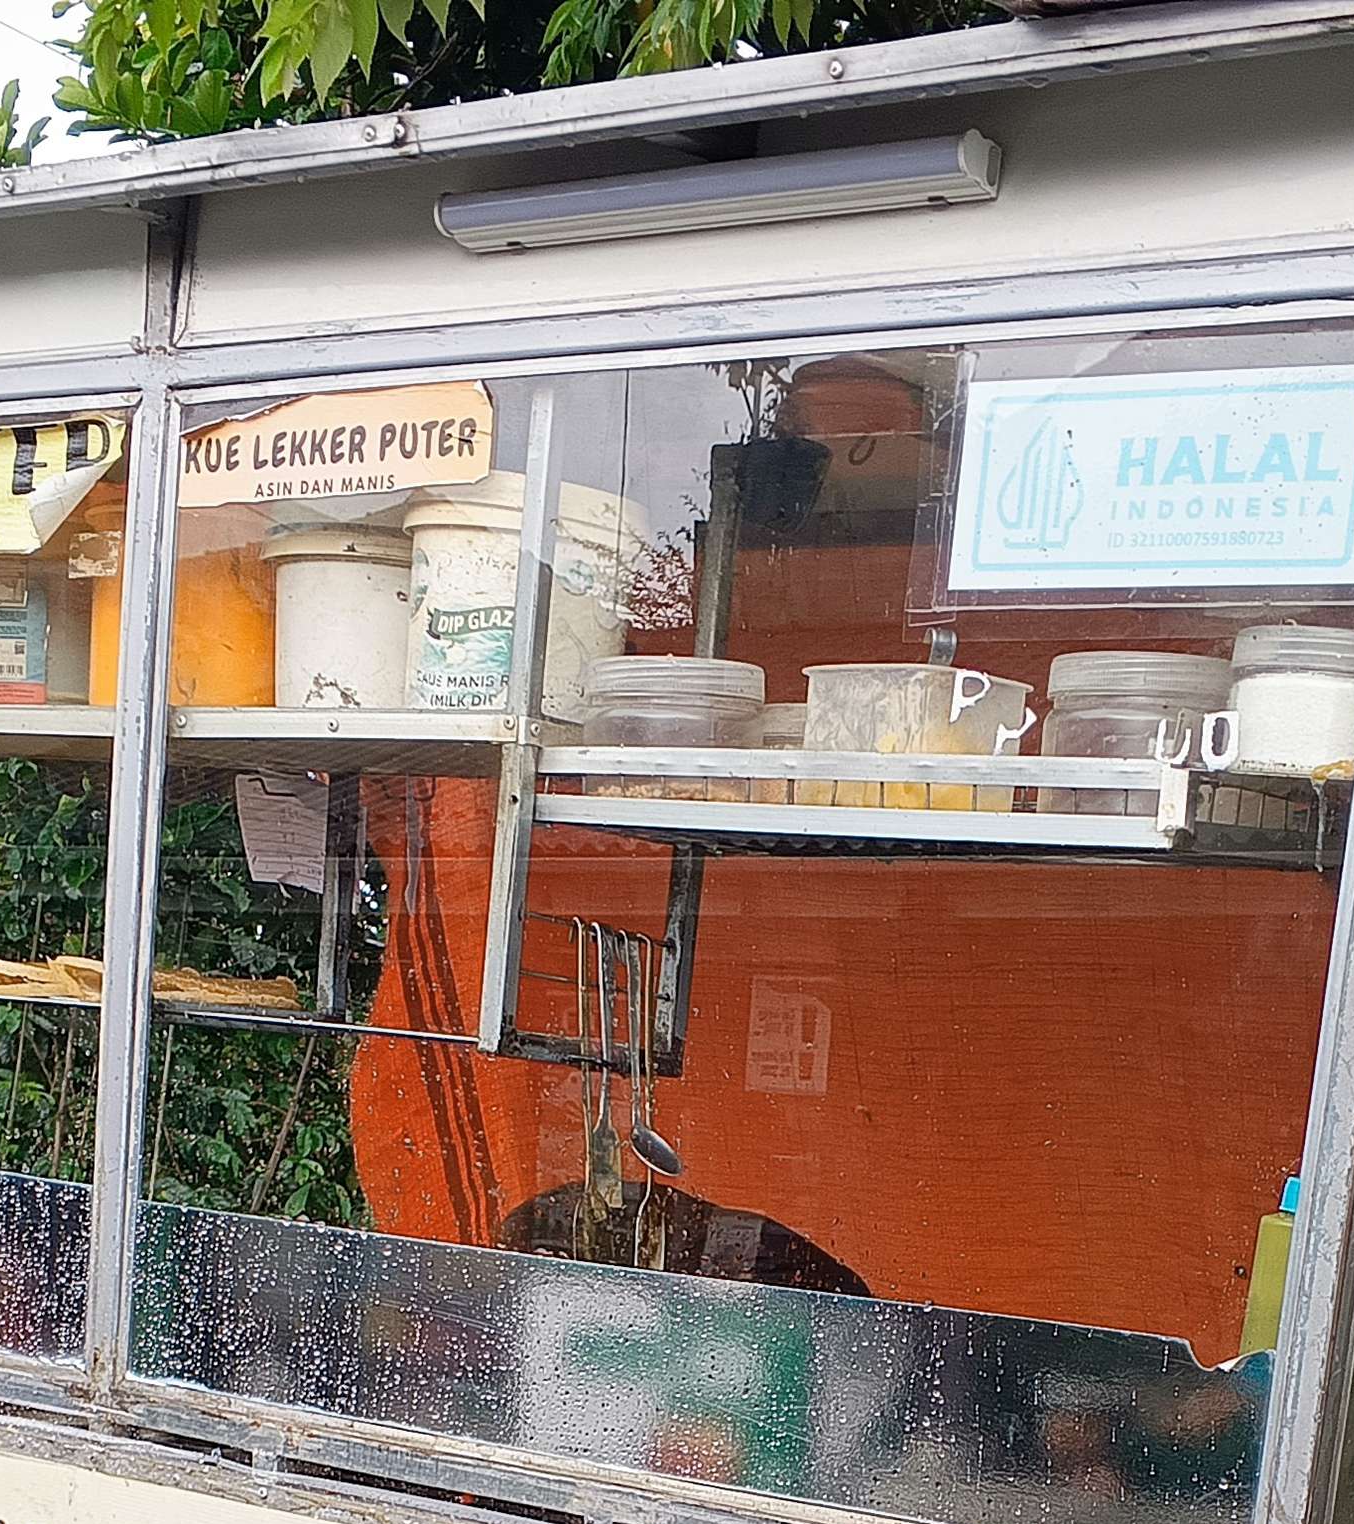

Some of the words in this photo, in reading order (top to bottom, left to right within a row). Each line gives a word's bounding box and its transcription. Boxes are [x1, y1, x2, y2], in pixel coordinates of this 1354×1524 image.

[183, 434, 242, 475] KUE
[252, 423, 367, 471] LEKKER
[378, 416, 478, 462] PUTER
[1115, 431, 1340, 487] HALAL
[254, 480, 293, 498] ASIN
[300, 478, 334, 496] DAN
[340, 474, 396, 492] MANIS
[1109, 495, 1335, 521] INDONESIA
[1107, 532, 1125, 549] ID
[437, 614, 465, 634] DIP
[467, 609, 515, 631] GLAZ
[447, 674, 495, 688] MANIS
